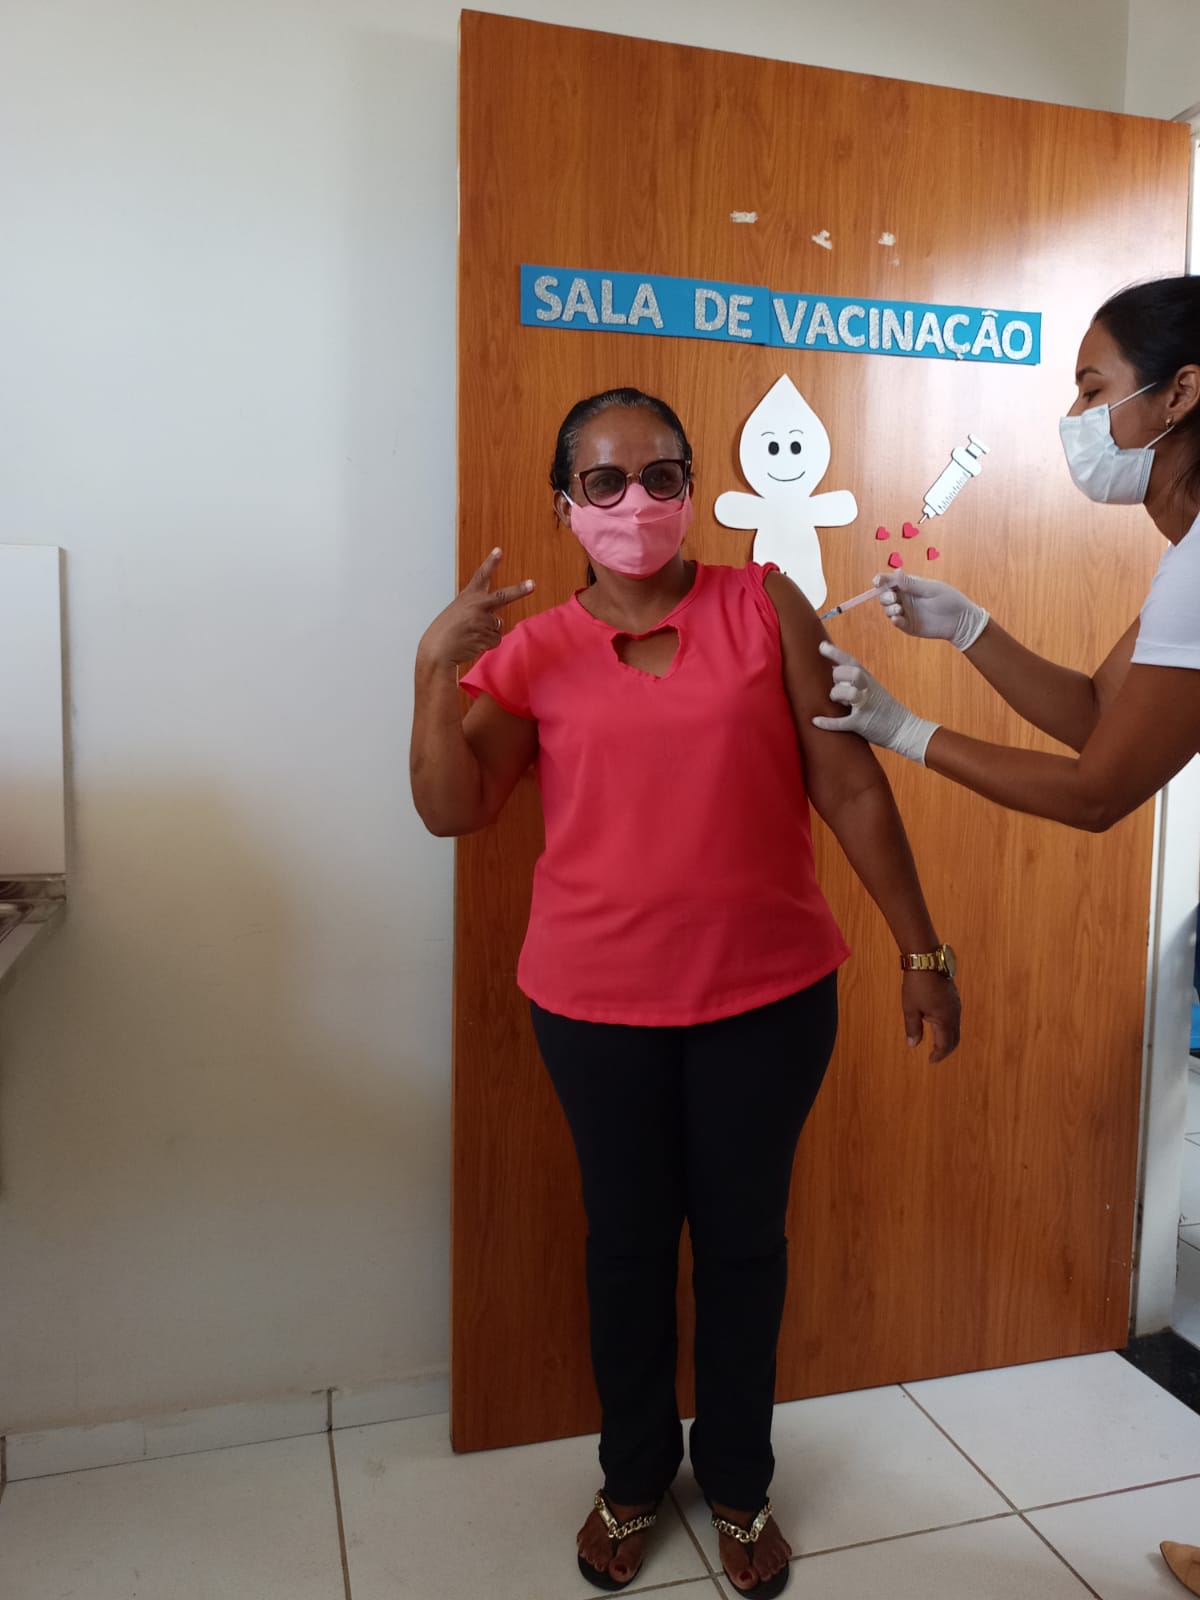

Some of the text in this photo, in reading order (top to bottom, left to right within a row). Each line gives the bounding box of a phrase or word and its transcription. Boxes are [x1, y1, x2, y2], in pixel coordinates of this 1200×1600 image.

[534, 275, 1033, 360] SALA DE VACINAÇÃO
